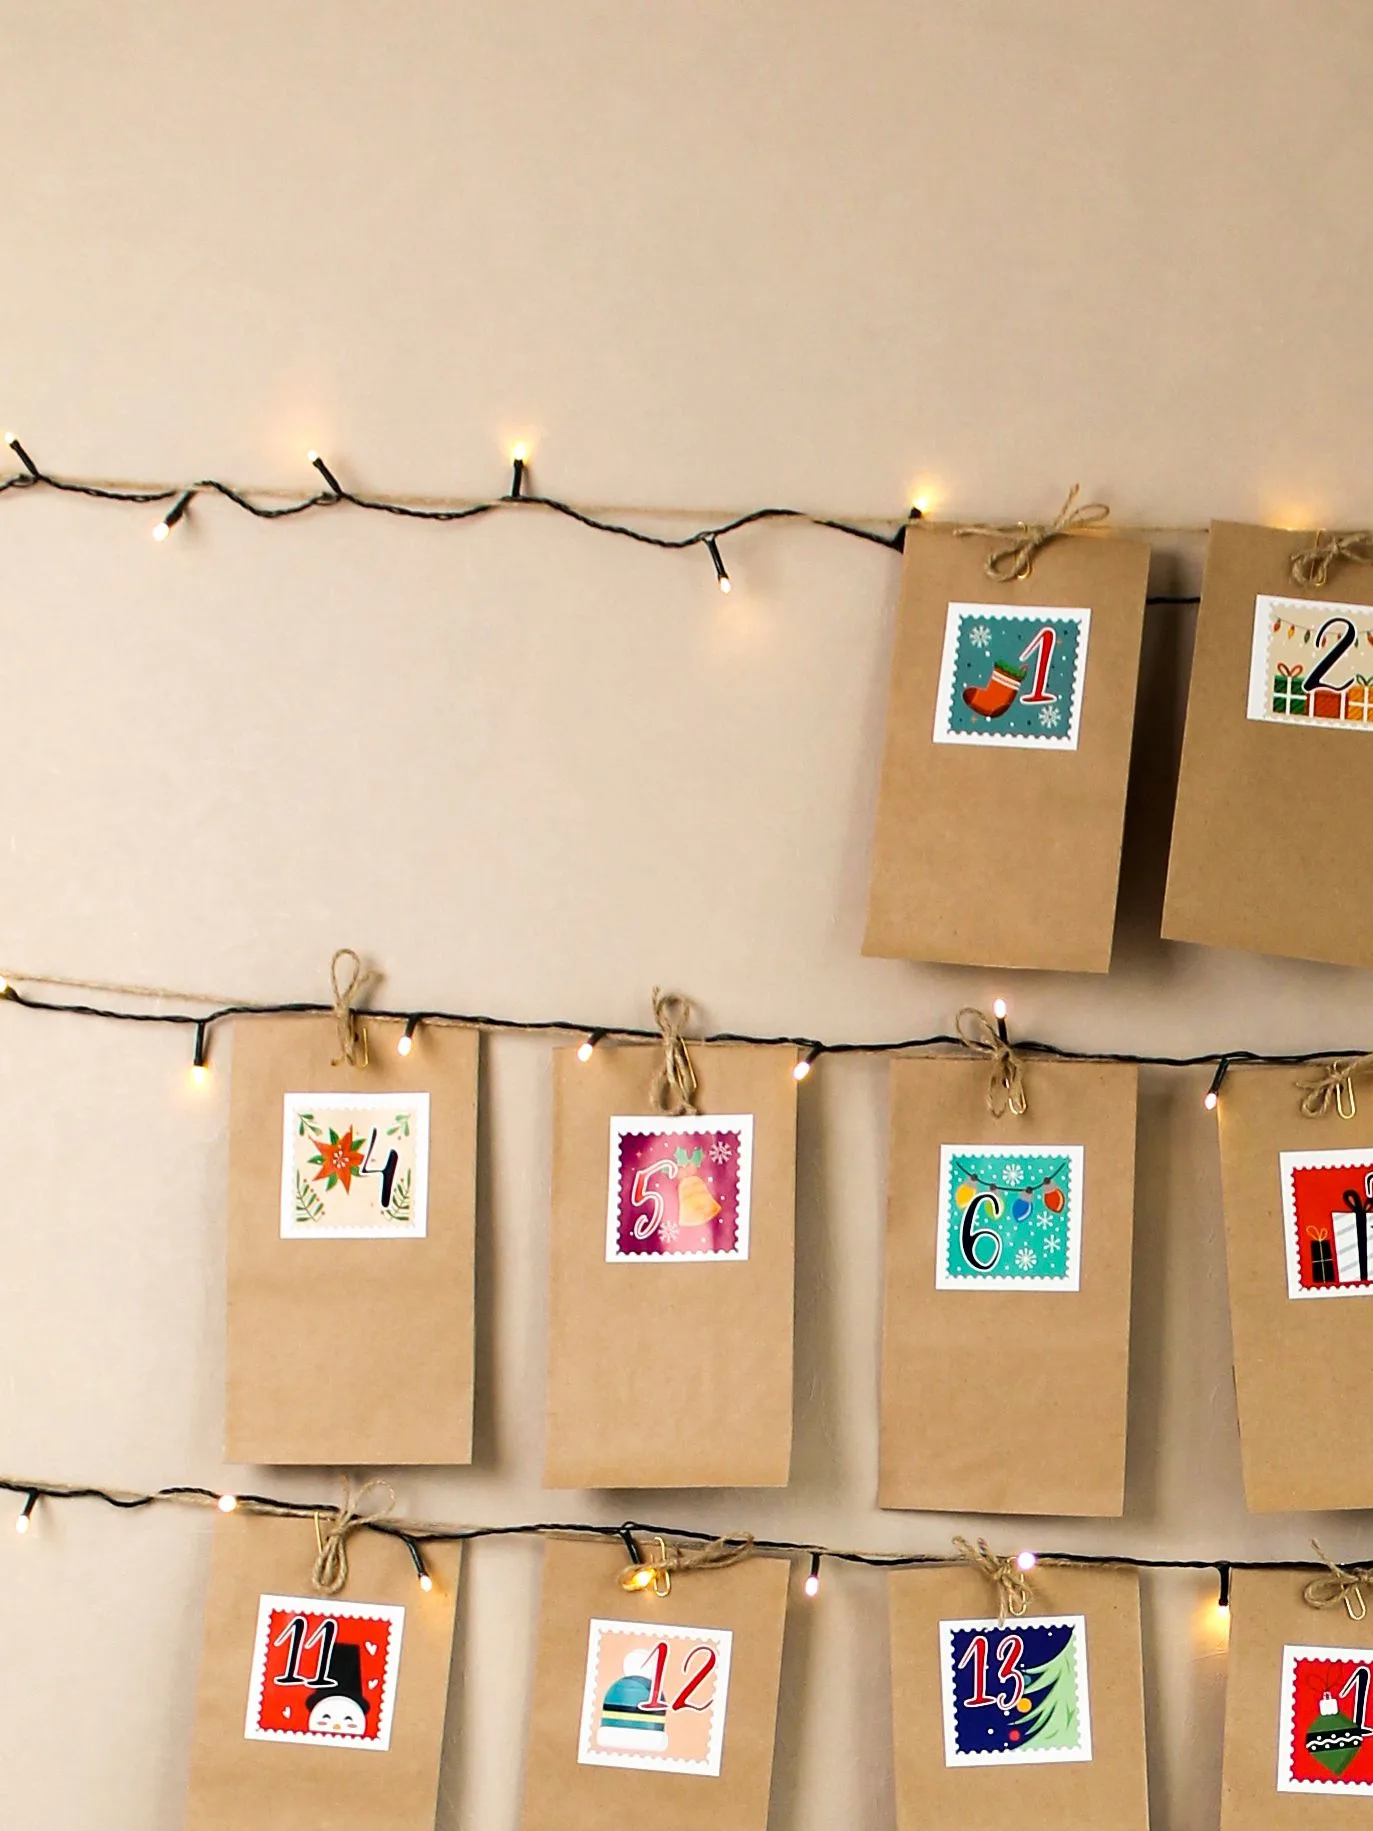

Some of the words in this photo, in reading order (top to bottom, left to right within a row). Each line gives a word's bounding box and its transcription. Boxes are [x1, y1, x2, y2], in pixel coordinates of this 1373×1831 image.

[1018, 626, 1057, 704] 1
[1302, 617, 1356, 692] 2
[361, 1127, 398, 1208] 4
[630, 1159, 677, 1239] 5
[961, 1193, 1002, 1272] 6
[273, 1615, 338, 1688] 11
[638, 1642, 716, 1710] 12
[958, 1635, 1026, 1709] 13
